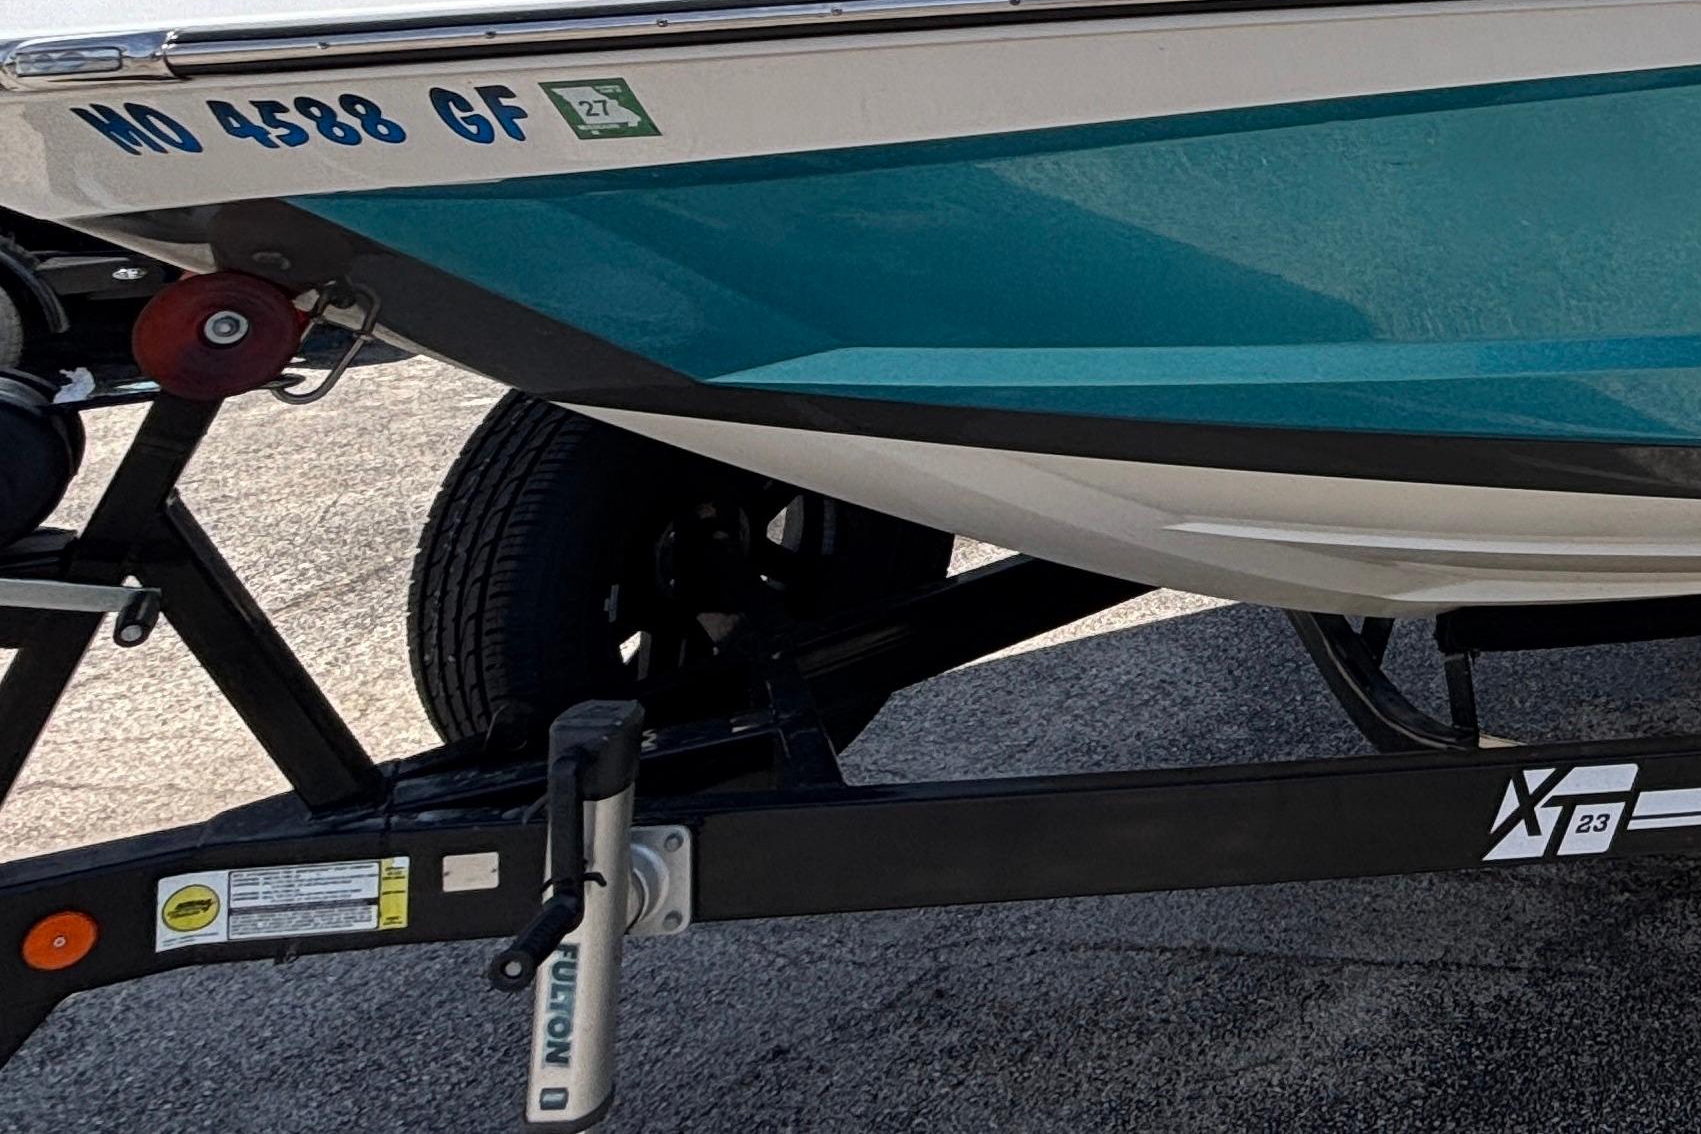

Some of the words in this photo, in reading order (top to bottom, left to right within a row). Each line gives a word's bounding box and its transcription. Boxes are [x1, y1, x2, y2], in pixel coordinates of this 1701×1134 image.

[69, 102, 204, 156] MO
[205, 93, 407, 149] 4588
[429, 85, 529, 144] GF
[578, 99, 610, 117] 27
[1575, 813, 1611, 834] 23
[545, 942, 580, 1065] FULTON
